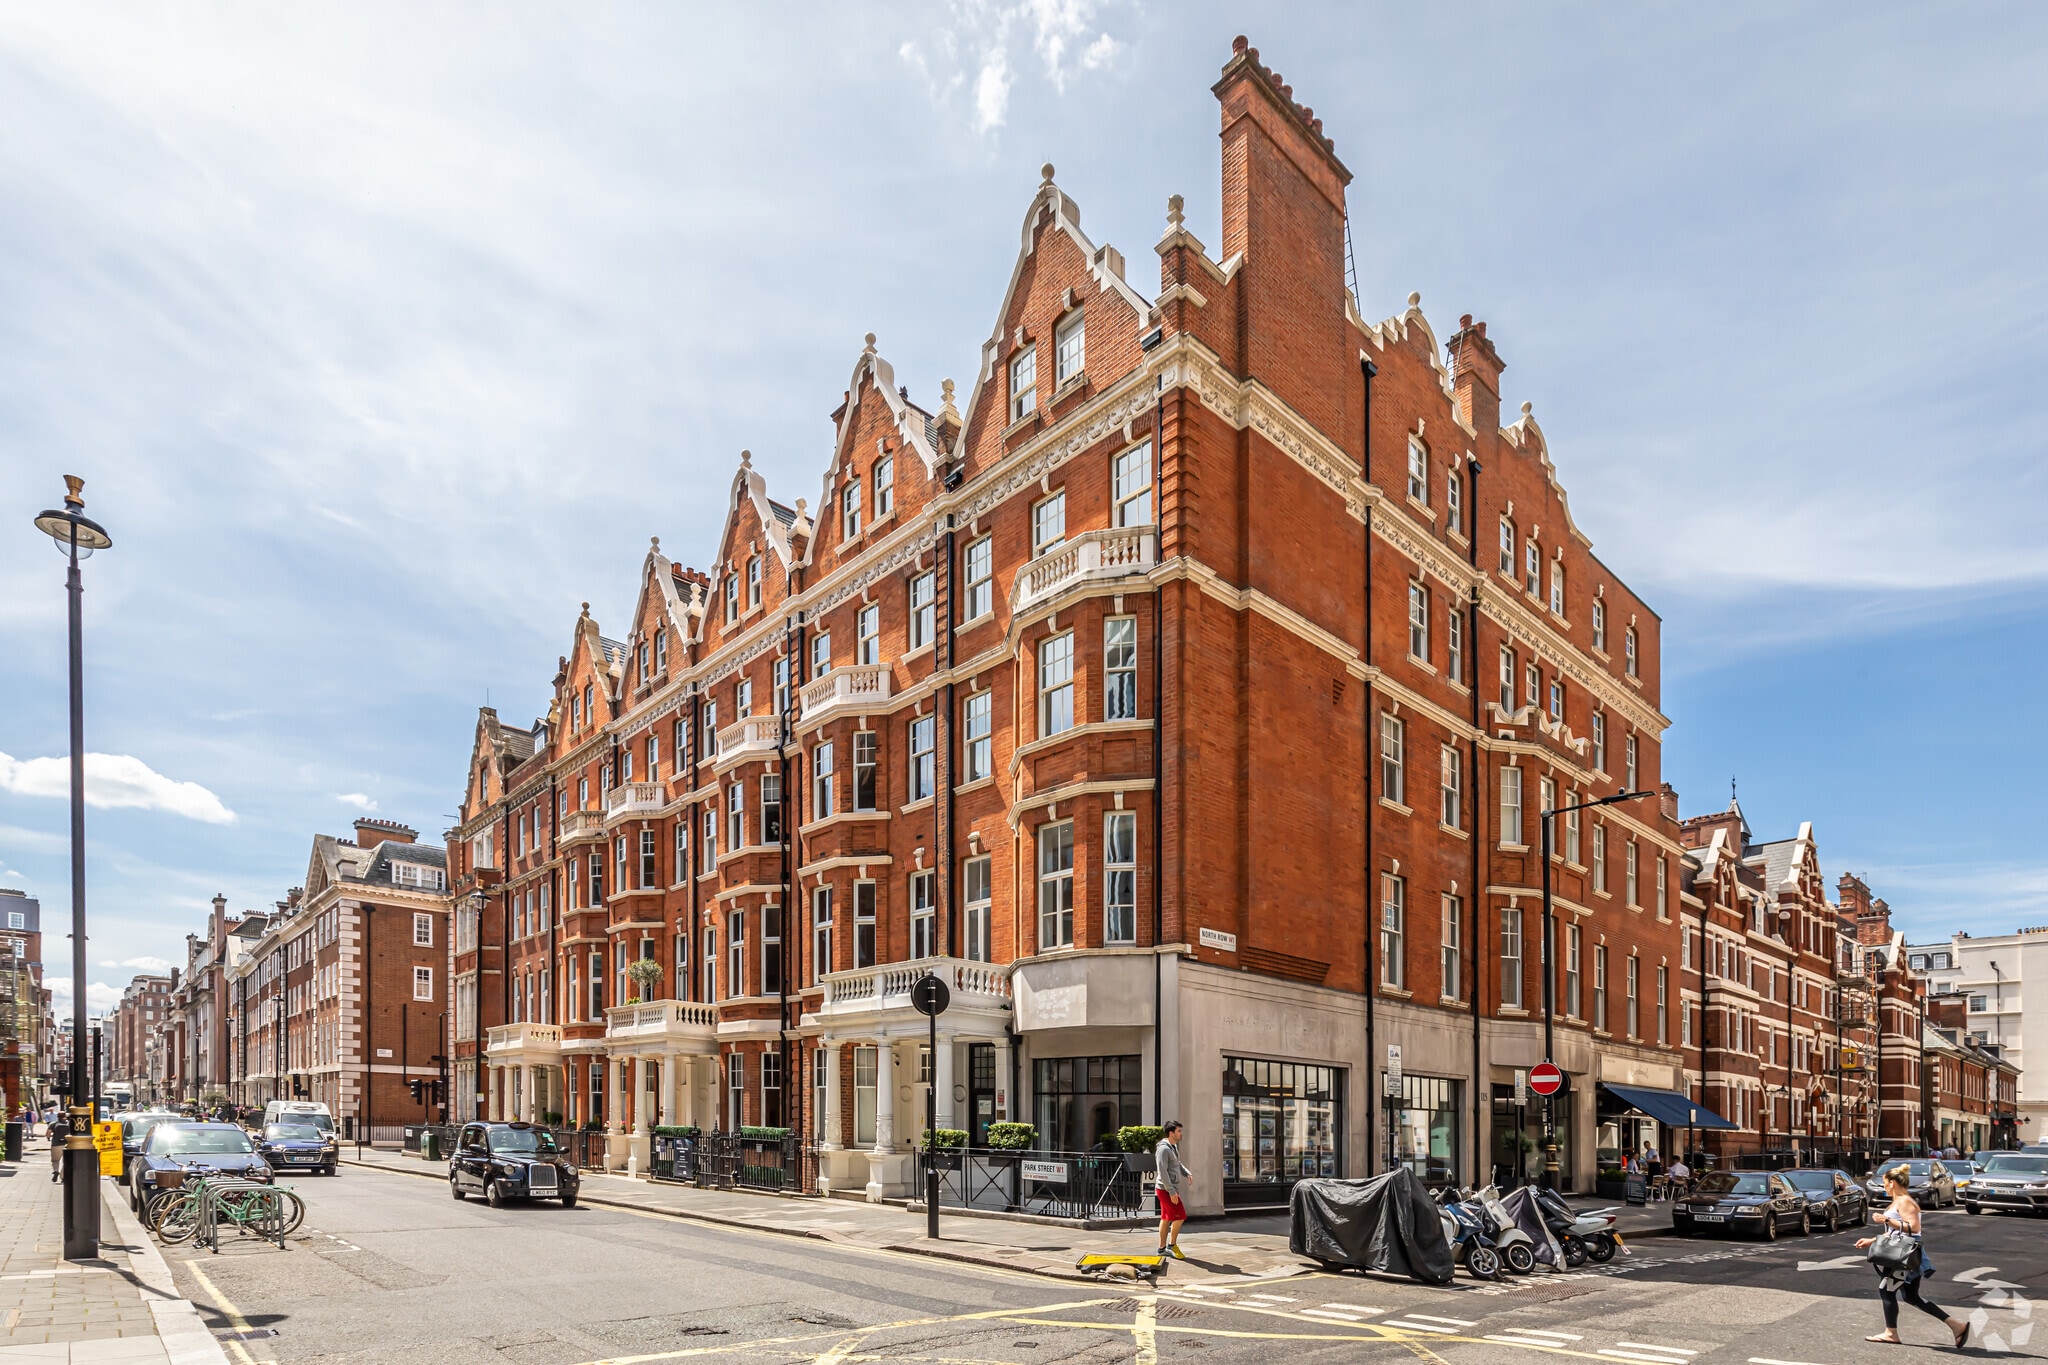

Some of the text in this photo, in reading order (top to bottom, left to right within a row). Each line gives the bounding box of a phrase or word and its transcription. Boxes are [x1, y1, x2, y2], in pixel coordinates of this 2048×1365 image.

[1201, 930, 1216, 940] NORTH
[1217, 933, 1228, 942] ROW
[1024, 1163, 1036, 1171] PARK
[1037, 1164, 1055, 1173] STREET
[1143, 1170, 1155, 1180] TO
